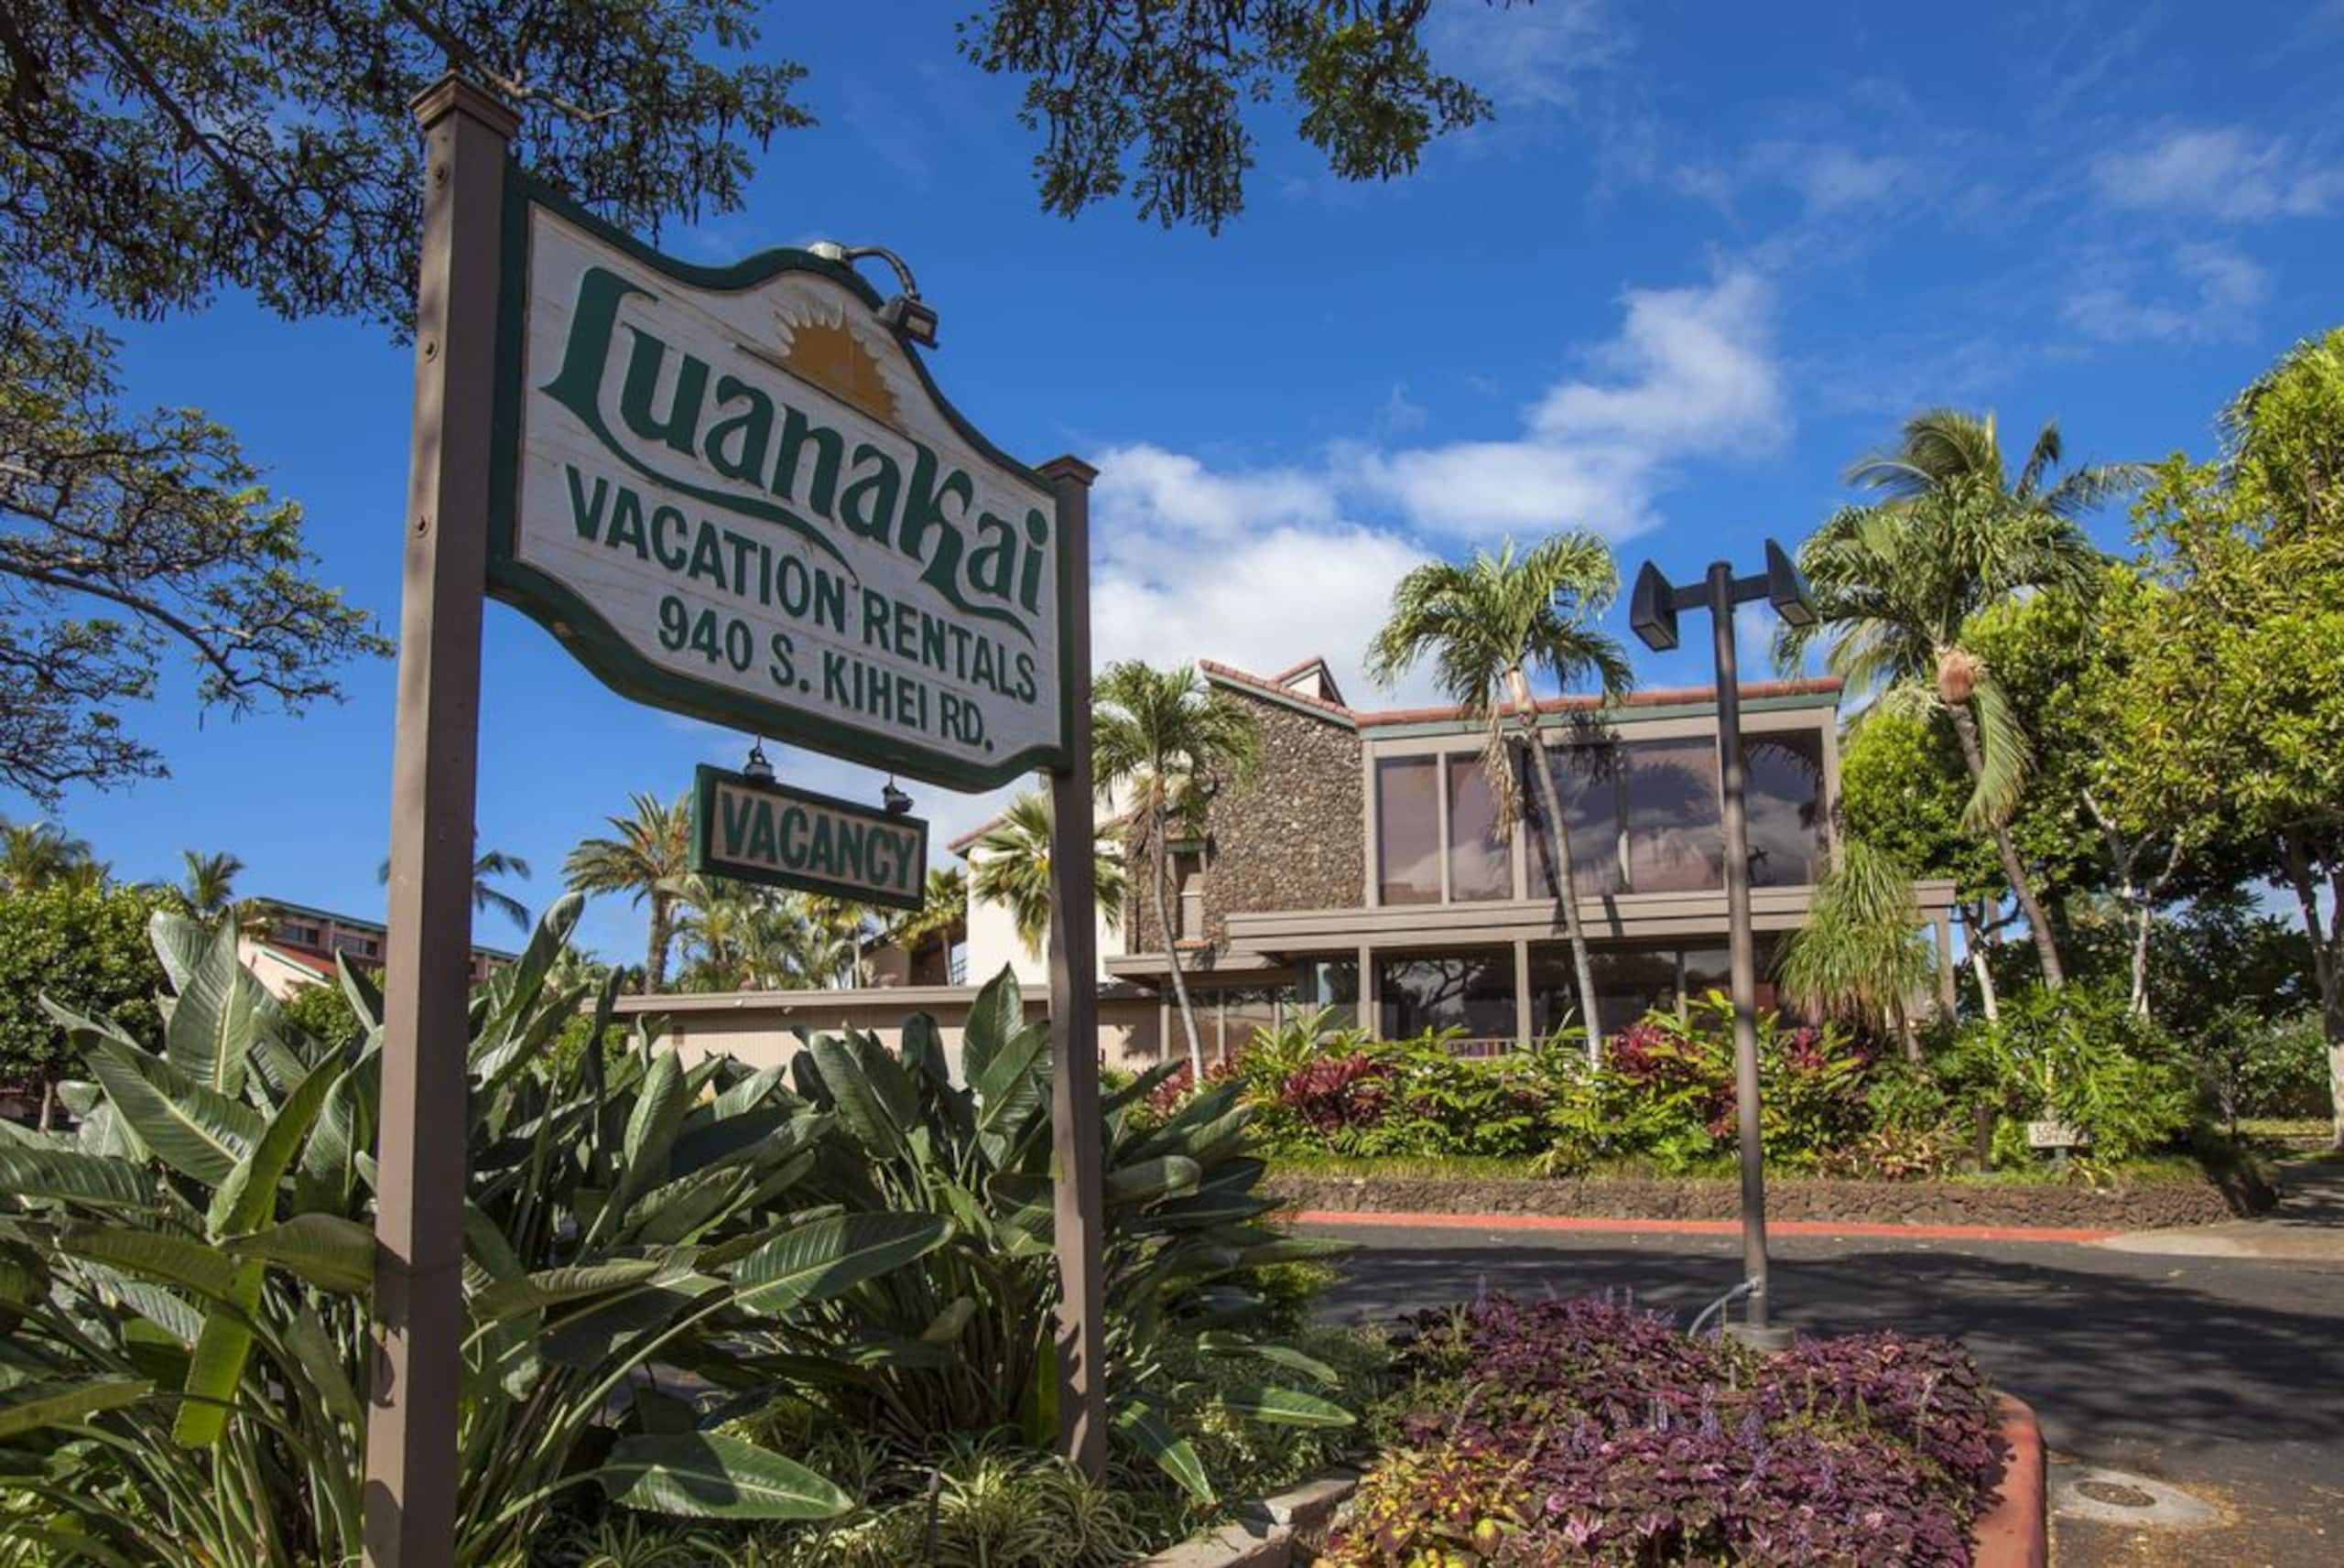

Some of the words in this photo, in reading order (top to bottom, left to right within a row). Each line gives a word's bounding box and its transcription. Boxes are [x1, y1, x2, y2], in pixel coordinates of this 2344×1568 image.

[565, 463, 847, 634] VACATION
[861, 587, 1038, 706] RENTALS
[657, 595, 754, 673] 940
[769, 633, 811, 694] S.
[823, 649, 928, 732] KIHEI
[939, 692, 995, 753] RD.
[722, 792, 916, 889] VACANCY
